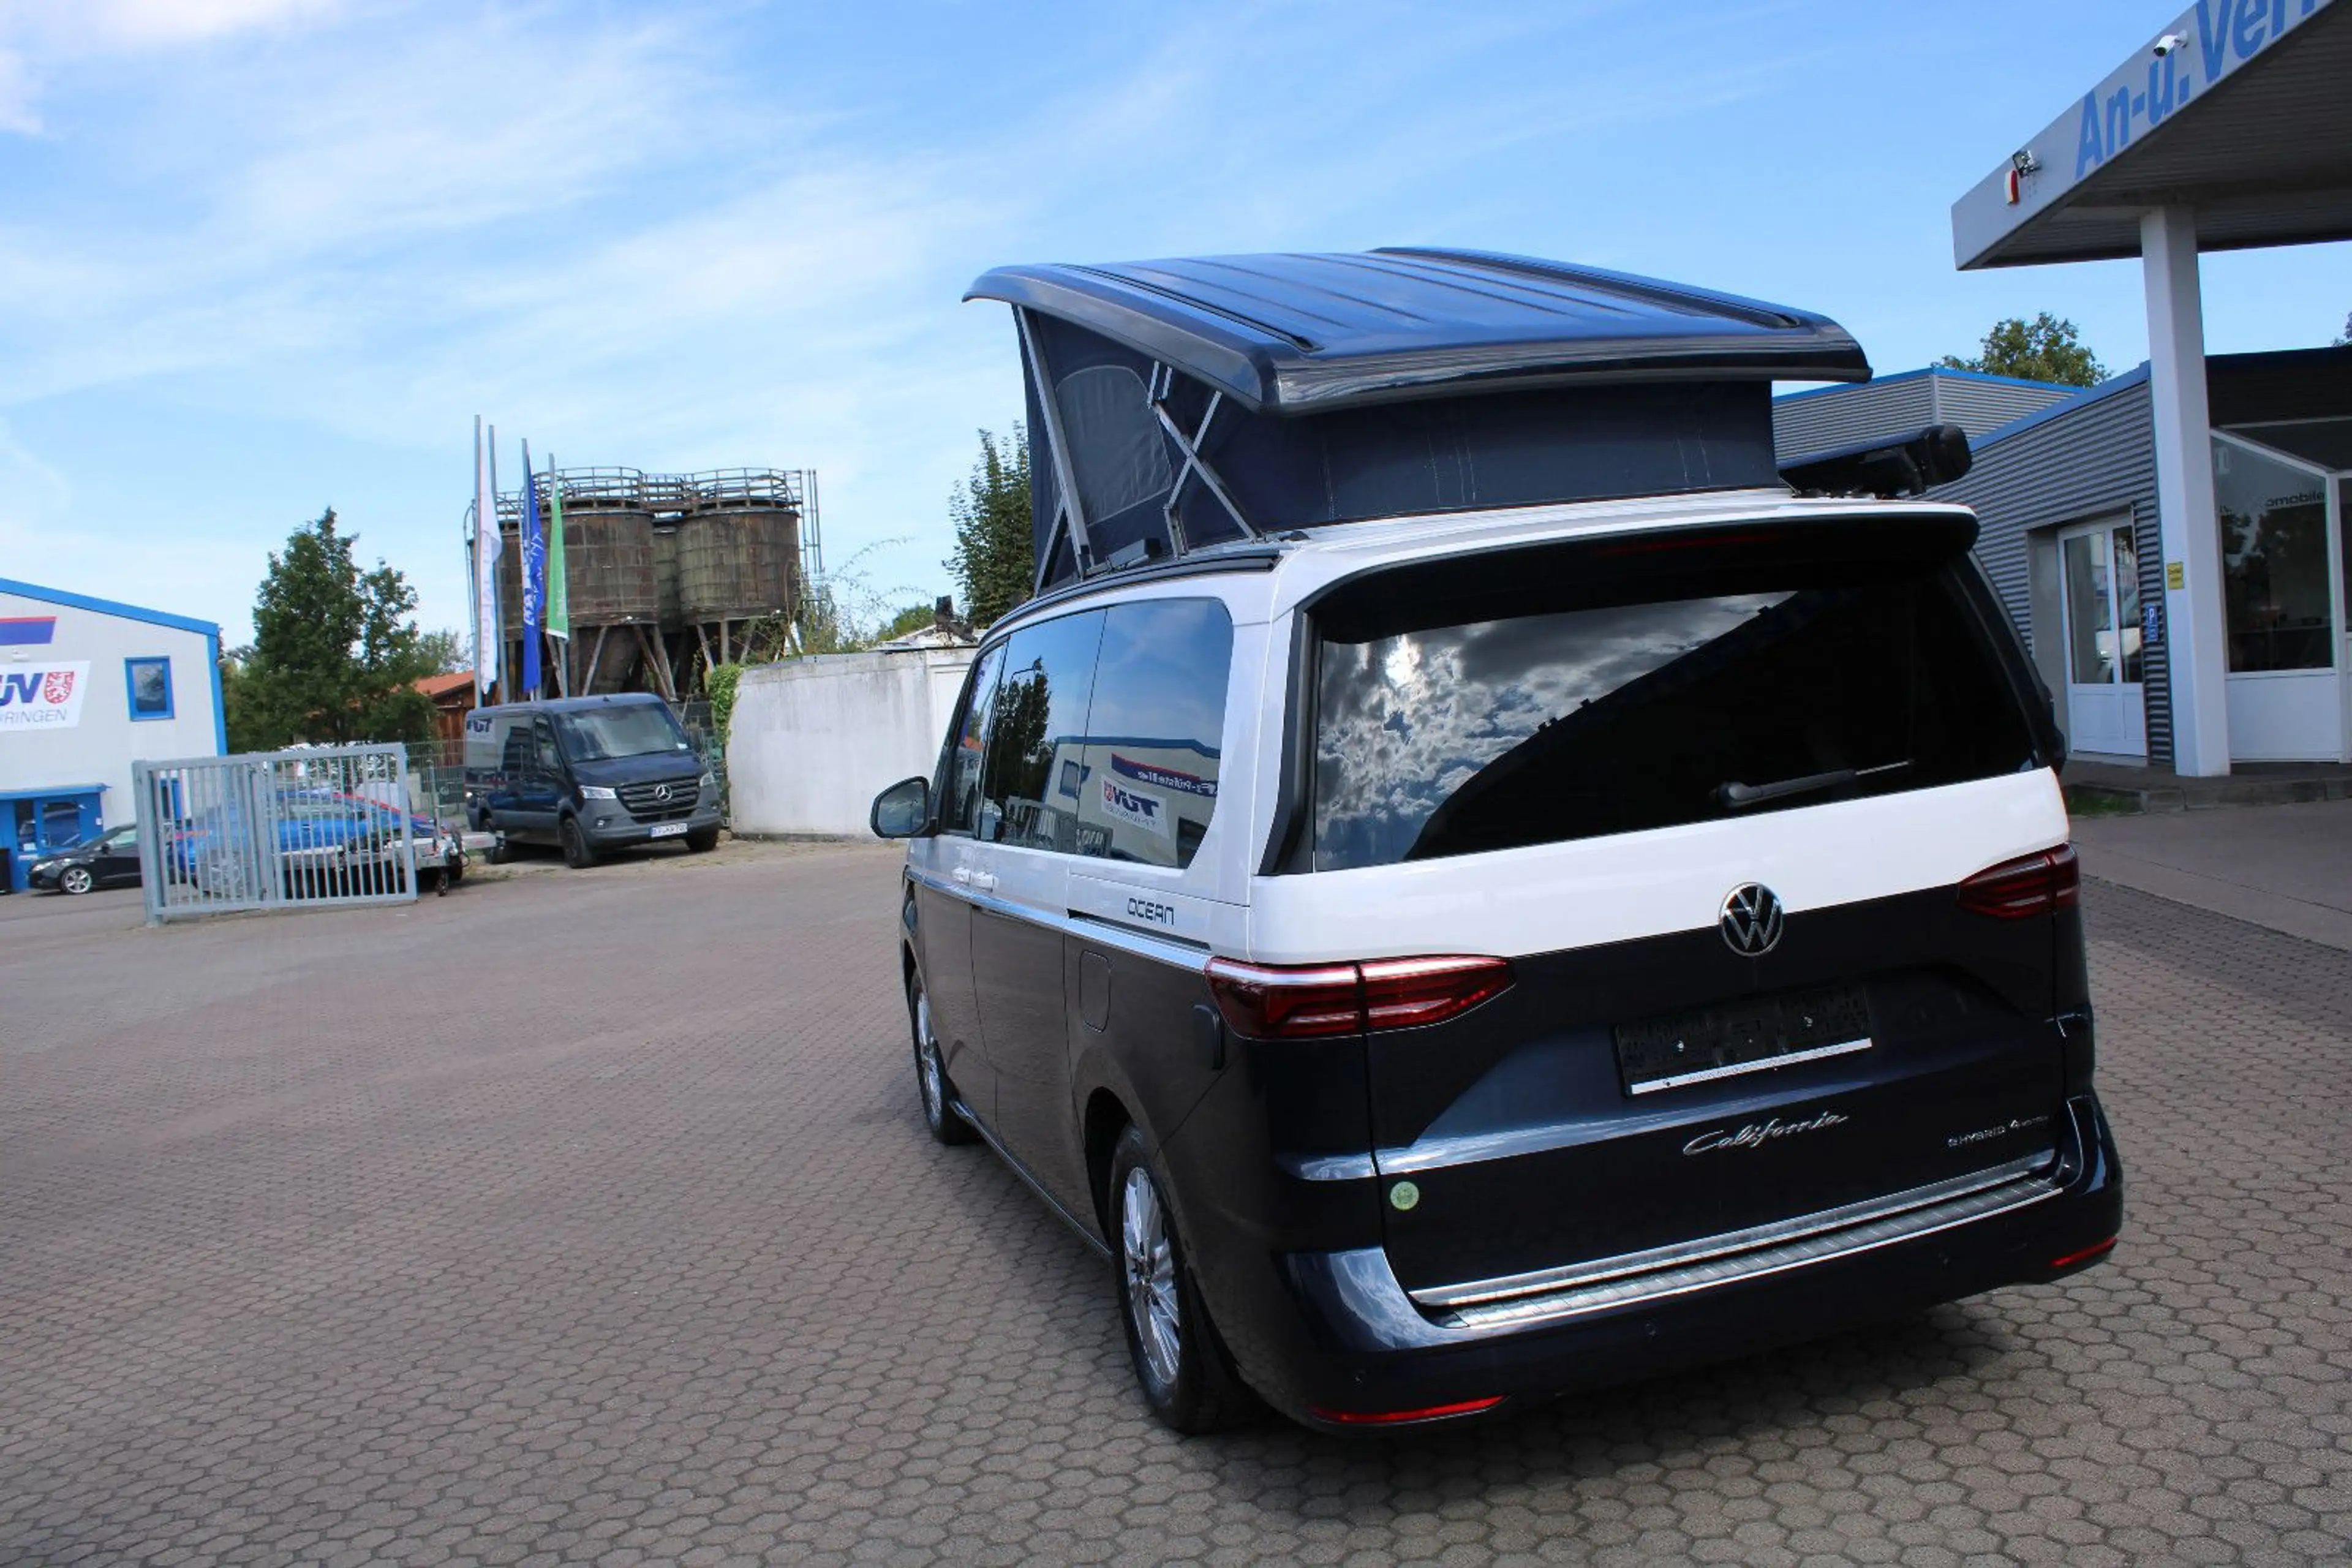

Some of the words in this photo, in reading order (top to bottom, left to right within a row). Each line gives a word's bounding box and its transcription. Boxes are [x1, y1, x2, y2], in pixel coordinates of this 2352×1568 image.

[2195, 0, 2316, 83] Ve
[0, 708, 67, 724] RINGEN
[1128, 898, 1174, 926] OCEAN
[1683, 1110, 1850, 1156] California
